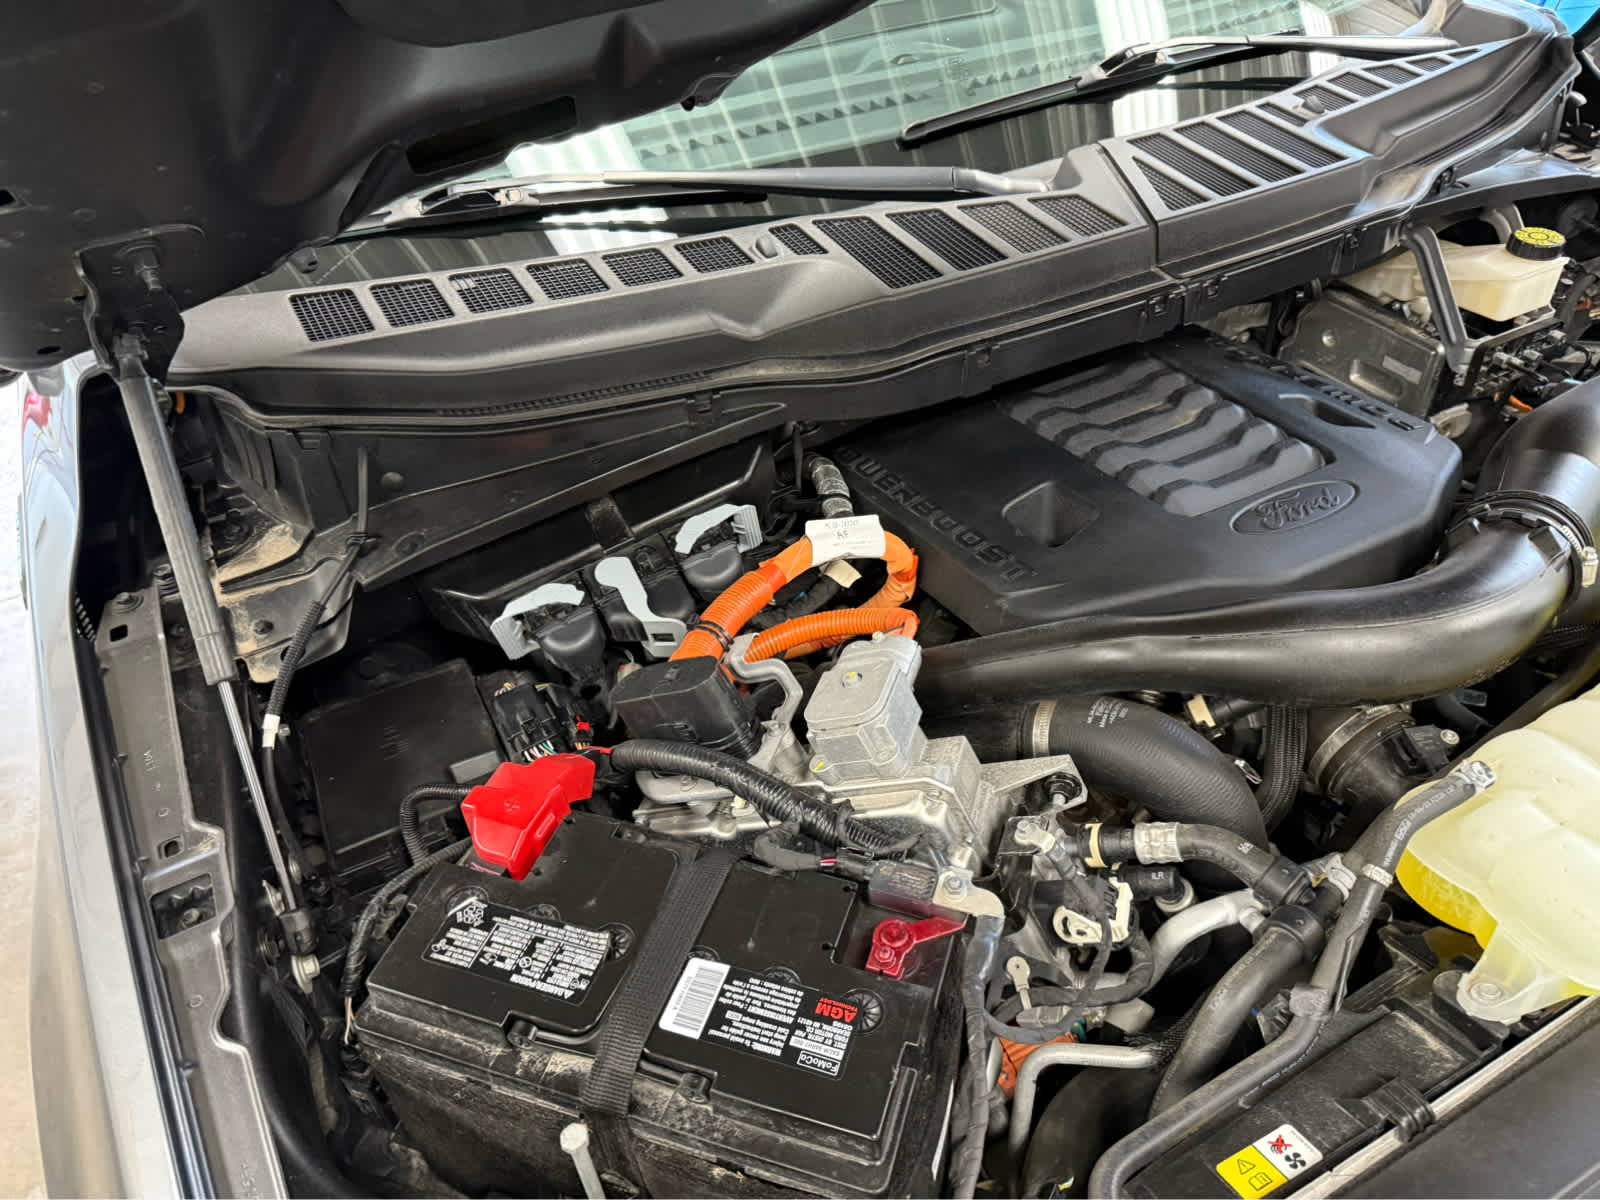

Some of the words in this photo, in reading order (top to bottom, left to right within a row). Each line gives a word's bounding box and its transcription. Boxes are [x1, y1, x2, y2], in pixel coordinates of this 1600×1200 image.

[834, 447, 1038, 585] OWERBOOST
[1256, 488, 1341, 530] Ford
[813, 1002, 856, 1024] AGM
[799, 1053, 837, 1072] FoMoCo
